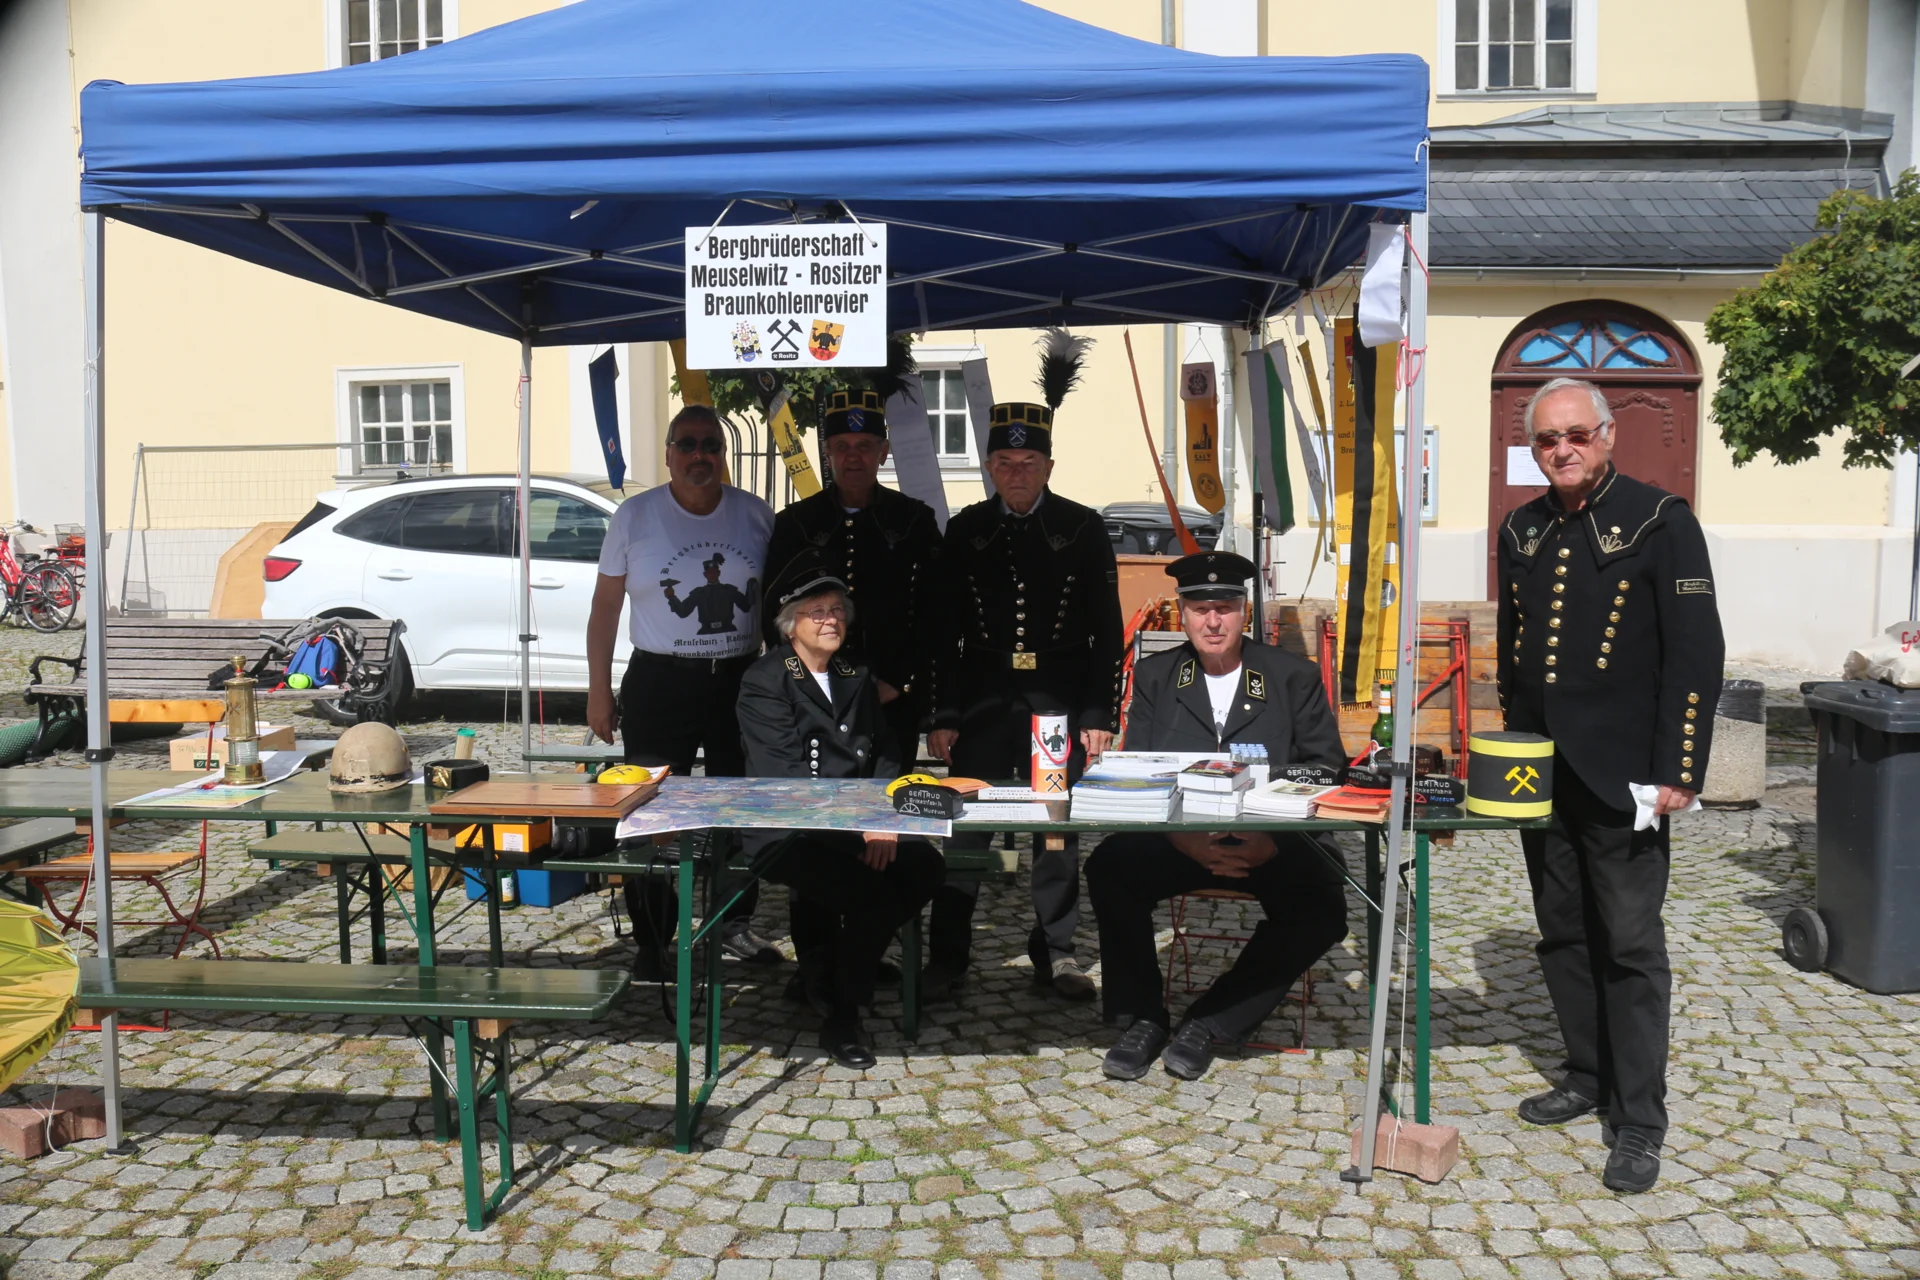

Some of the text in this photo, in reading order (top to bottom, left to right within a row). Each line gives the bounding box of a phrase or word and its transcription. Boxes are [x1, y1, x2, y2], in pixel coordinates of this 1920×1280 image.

[708, 233, 864, 260] Bergbrüderschaft
[691, 263, 788, 288] Meuselwitz
[810, 262, 882, 286] Rositzer
[704, 291, 869, 316] Braunkohlenrevier
[908, 789, 941, 800] GERTRUD
